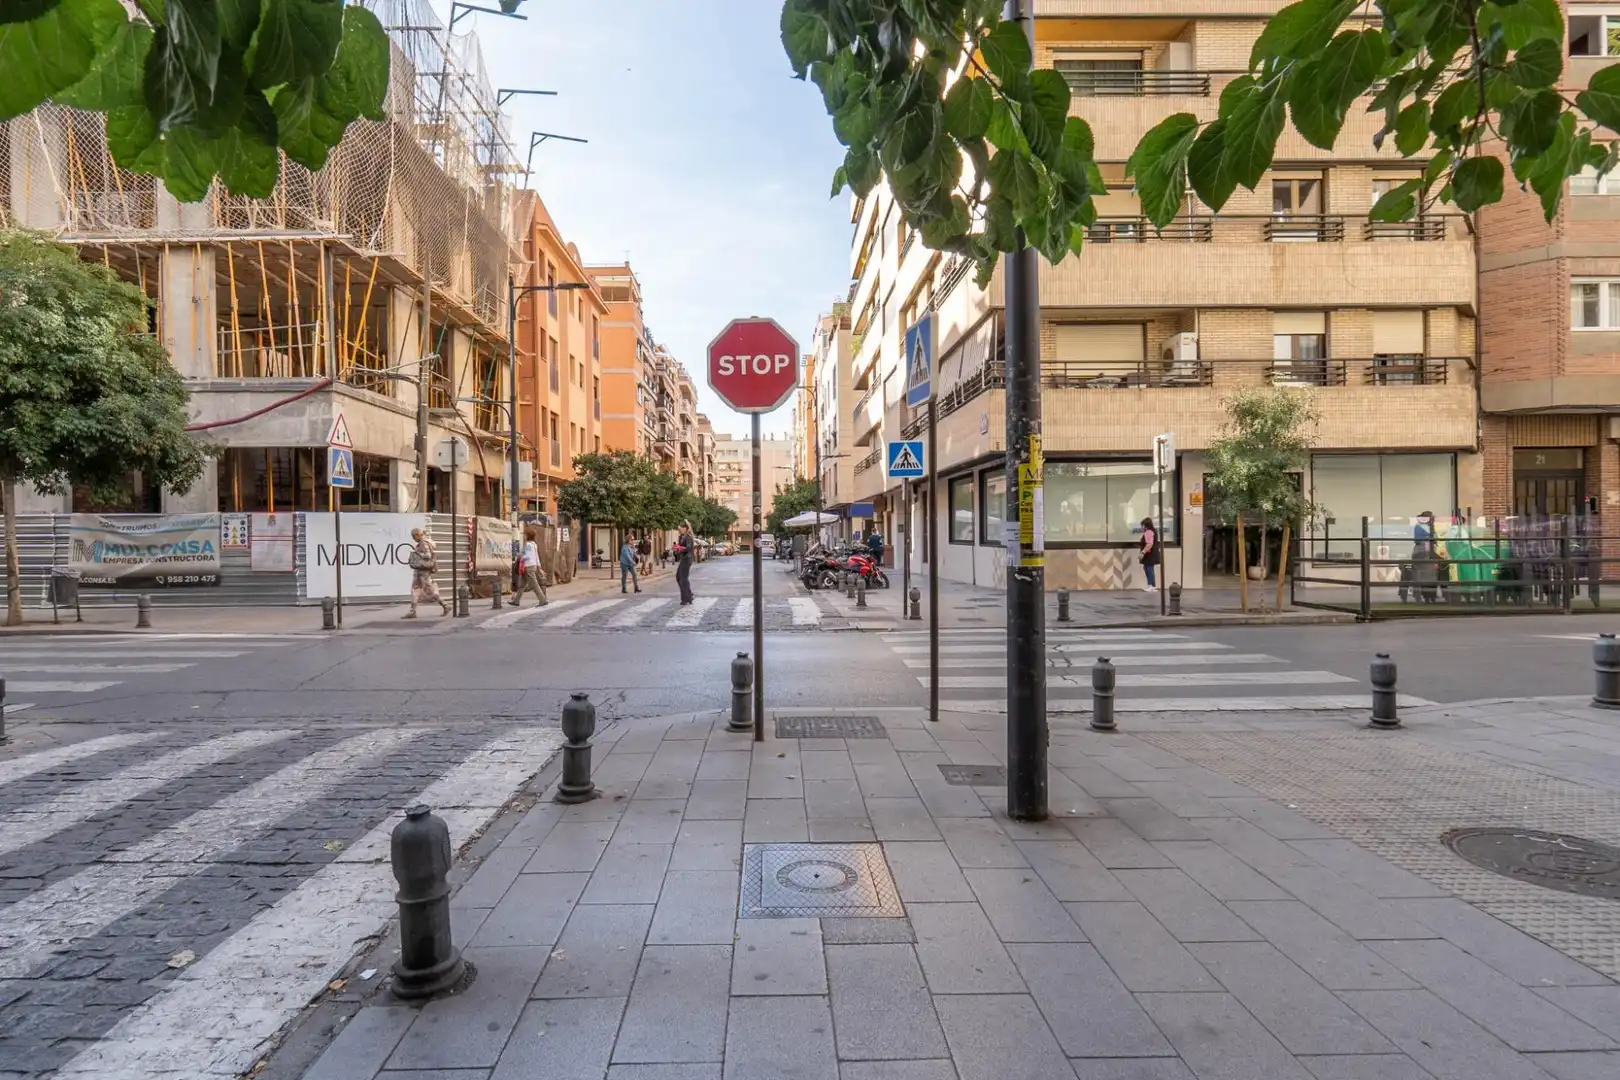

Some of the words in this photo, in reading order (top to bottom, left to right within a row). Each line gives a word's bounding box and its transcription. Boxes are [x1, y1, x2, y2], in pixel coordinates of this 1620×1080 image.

[718, 354, 790, 376] STOP
[1535, 454, 1546, 465] 21
[104, 540, 215, 558] MULCONSA
[103, 556, 144, 565] EMPRESA
[167, 575, 183, 583] 958
[200, 574, 216, 582] 475
